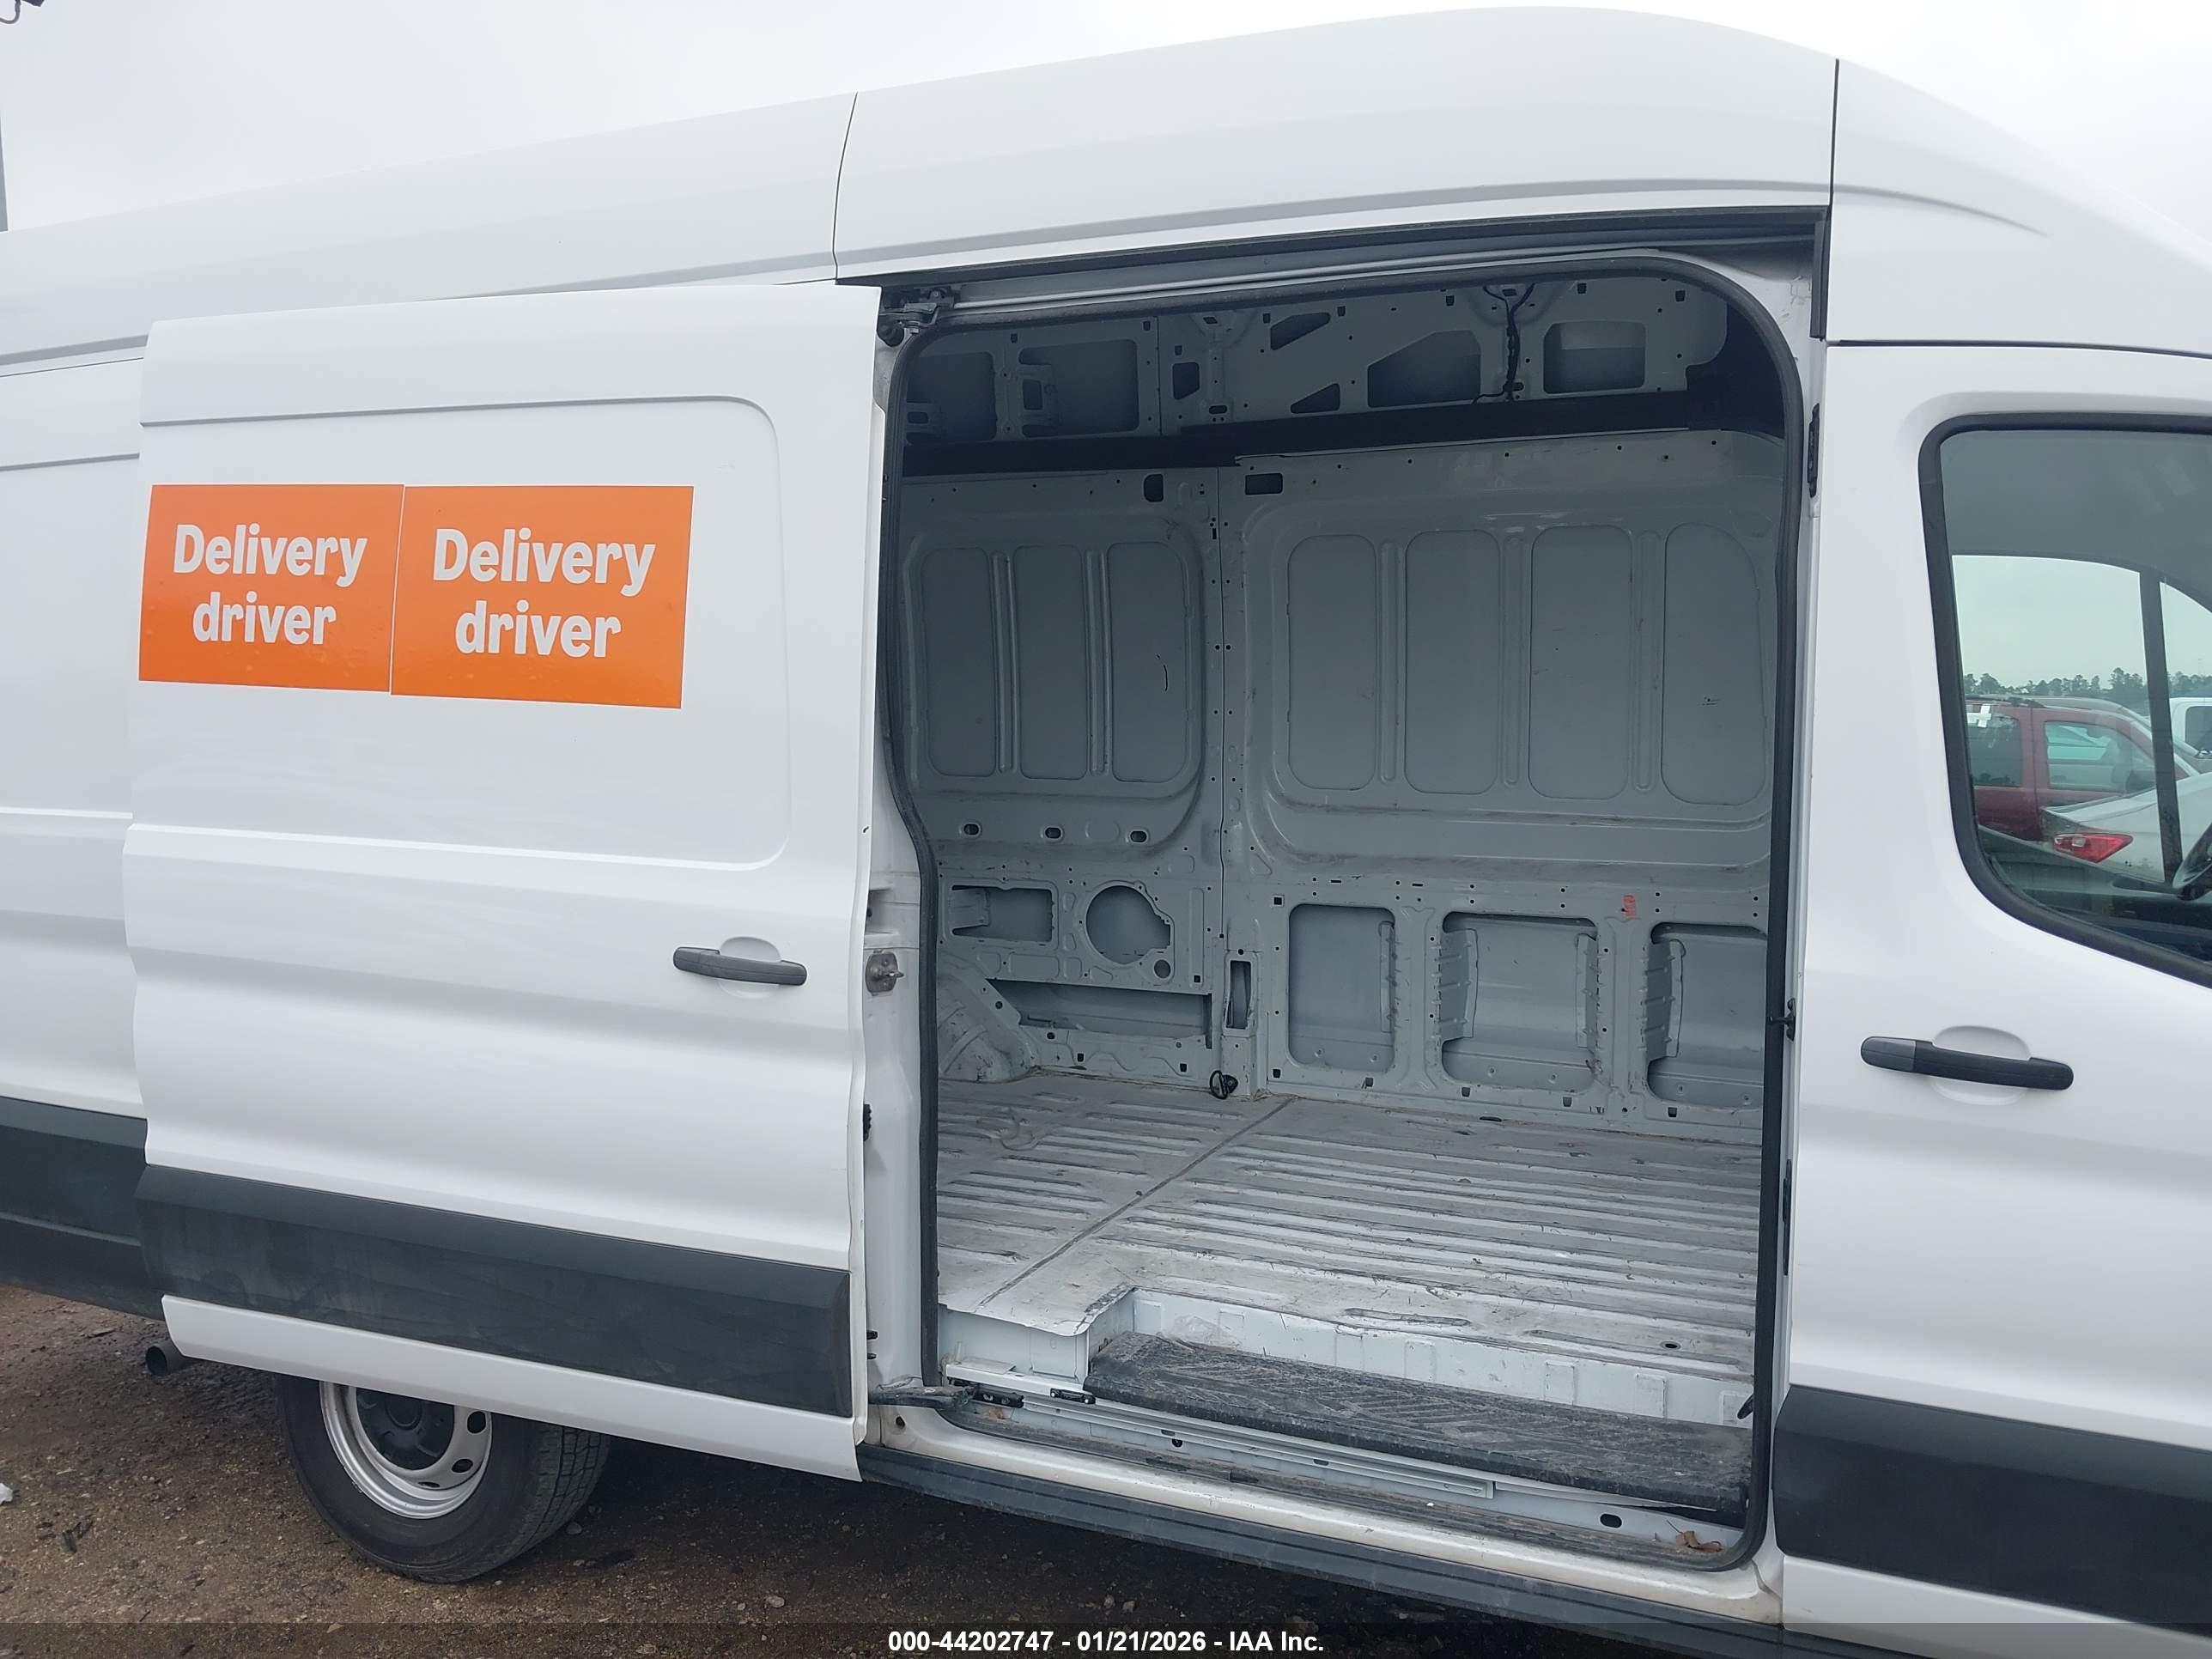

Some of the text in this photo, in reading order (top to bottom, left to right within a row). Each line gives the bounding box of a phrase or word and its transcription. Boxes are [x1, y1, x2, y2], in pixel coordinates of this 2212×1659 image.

[173, 523, 368, 587] Delivery
[433, 527, 655, 597] Delivery
[193, 592, 336, 647] driver
[455, 599, 621, 657] driver
